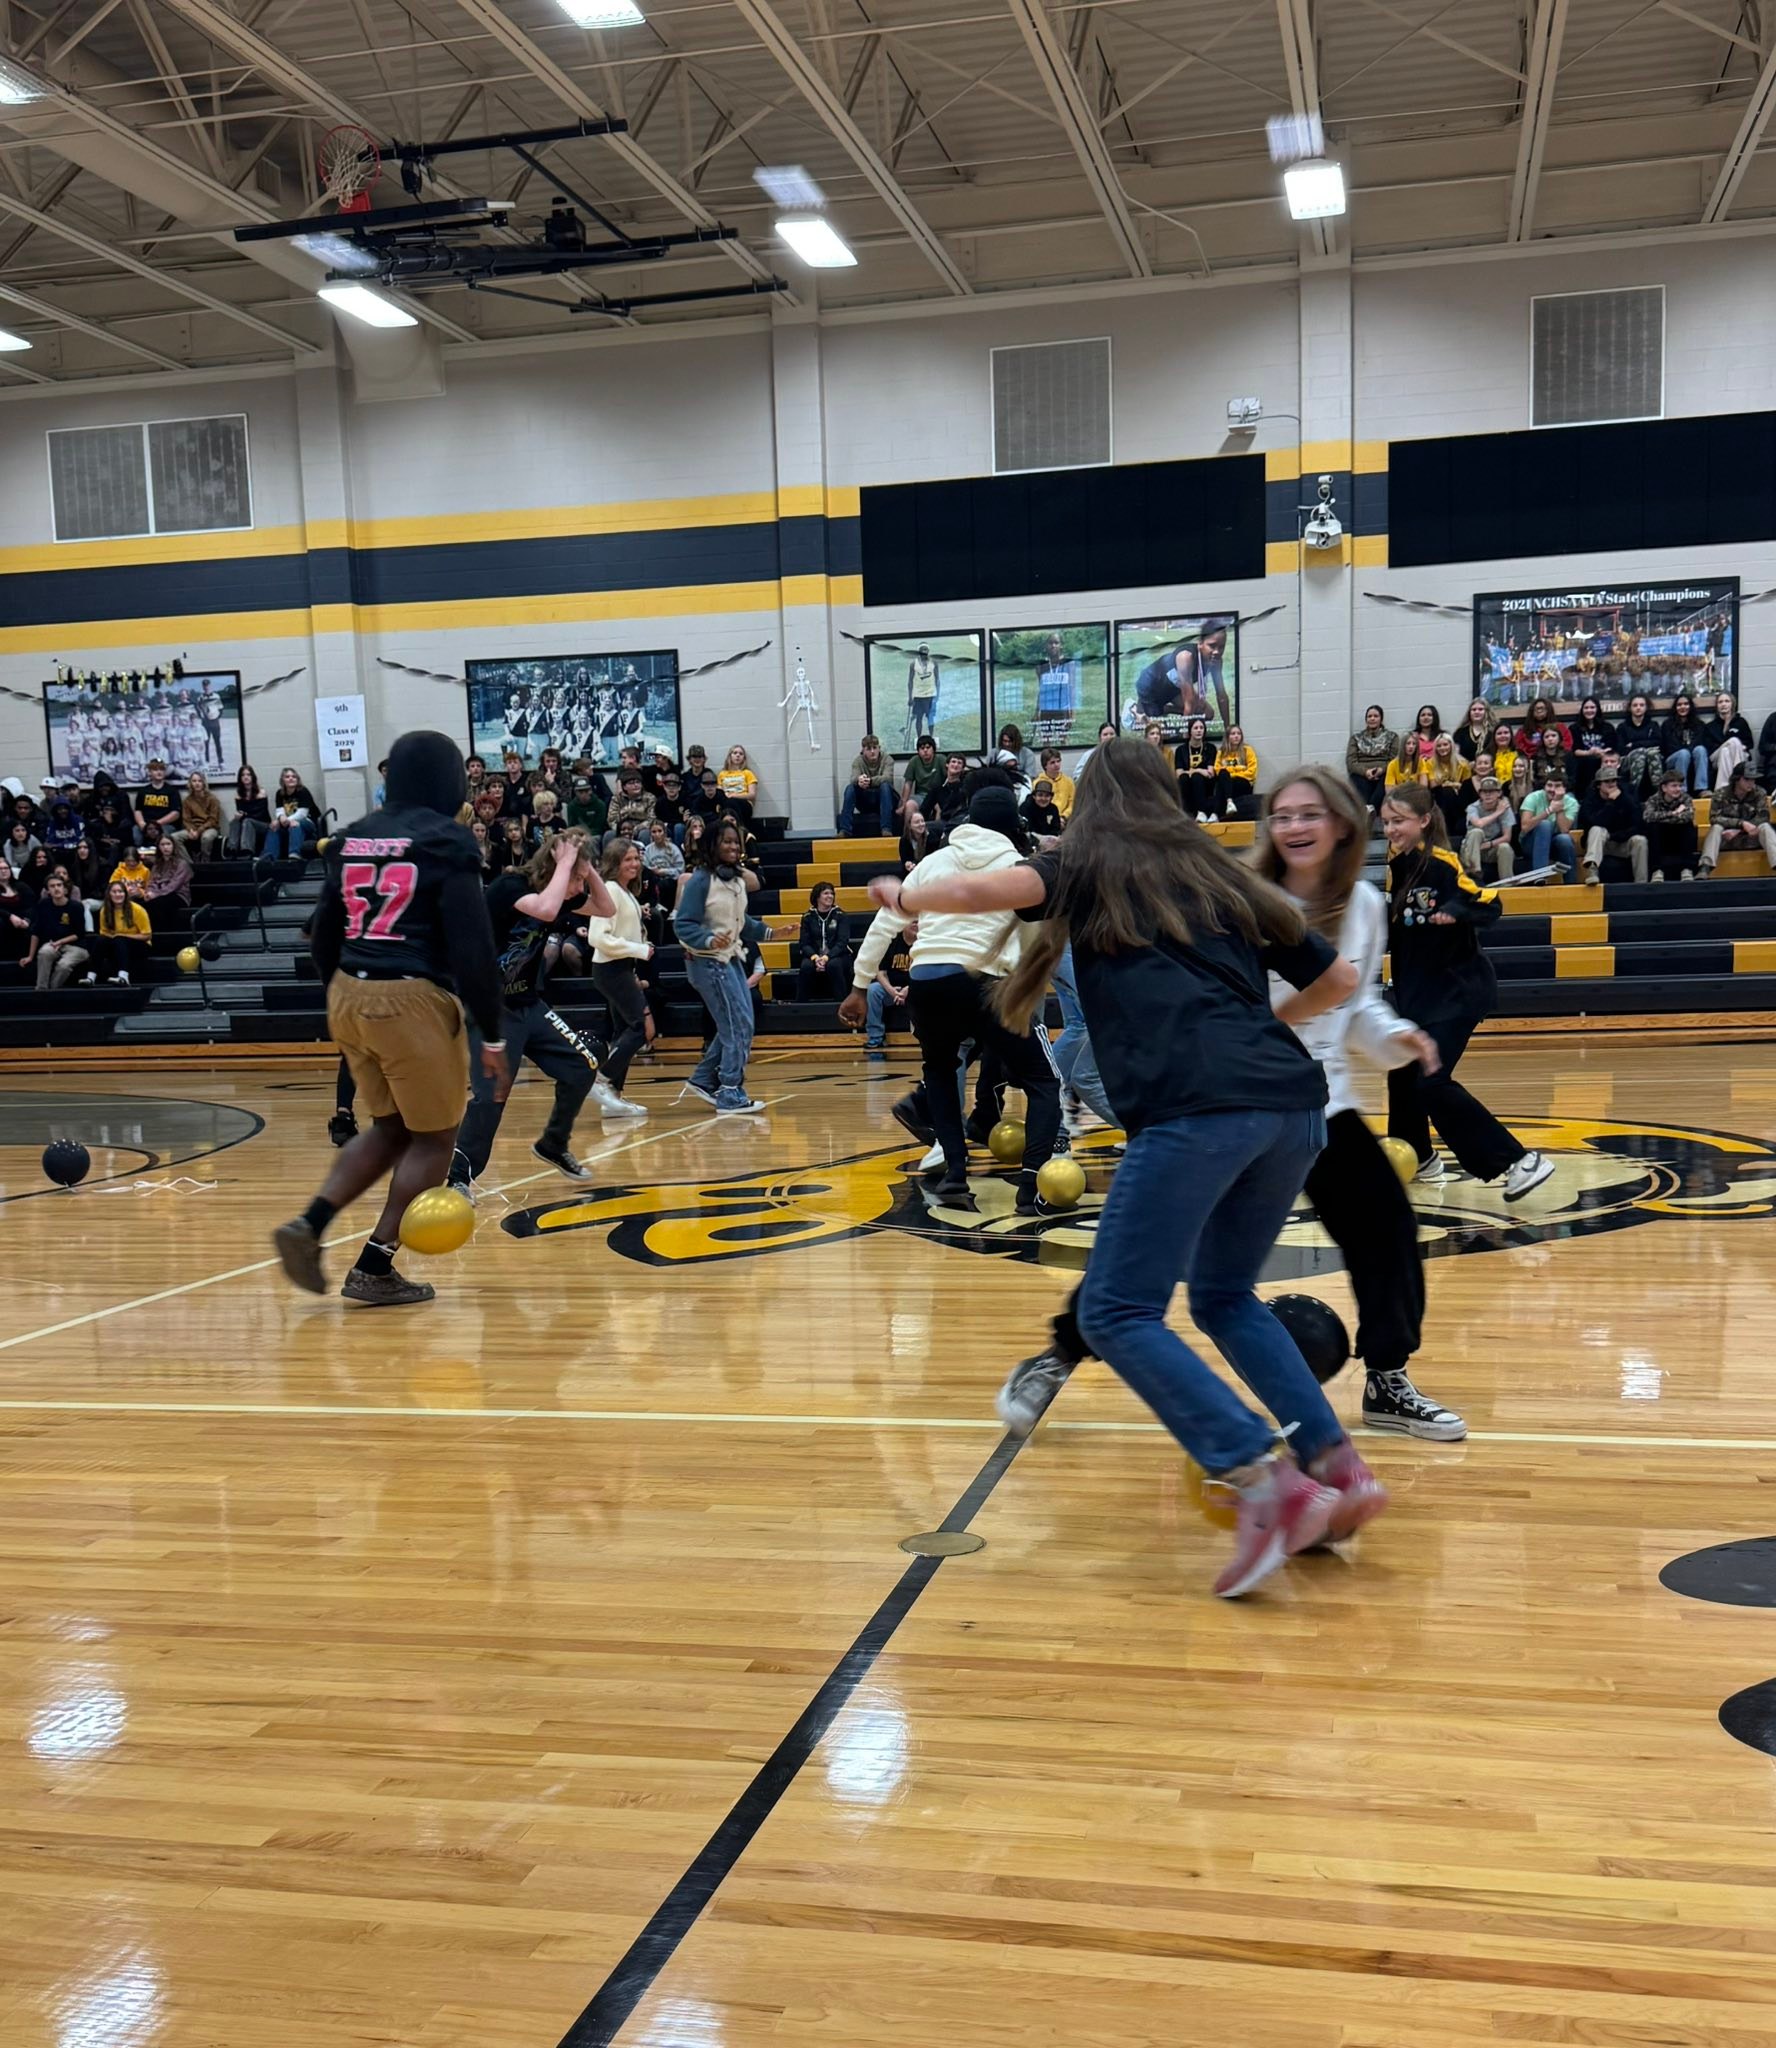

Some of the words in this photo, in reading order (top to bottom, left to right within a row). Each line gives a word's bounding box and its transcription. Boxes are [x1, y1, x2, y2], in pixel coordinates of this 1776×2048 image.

[1502, 599, 1530, 612] 2021
[1606, 592, 1638, 604] State
[1640, 588, 1711, 603] Champions
[334, 703, 349, 713] 9th
[327, 727, 350, 736] Class
[350, 726, 359, 734] of
[341, 861, 419, 941] 52
